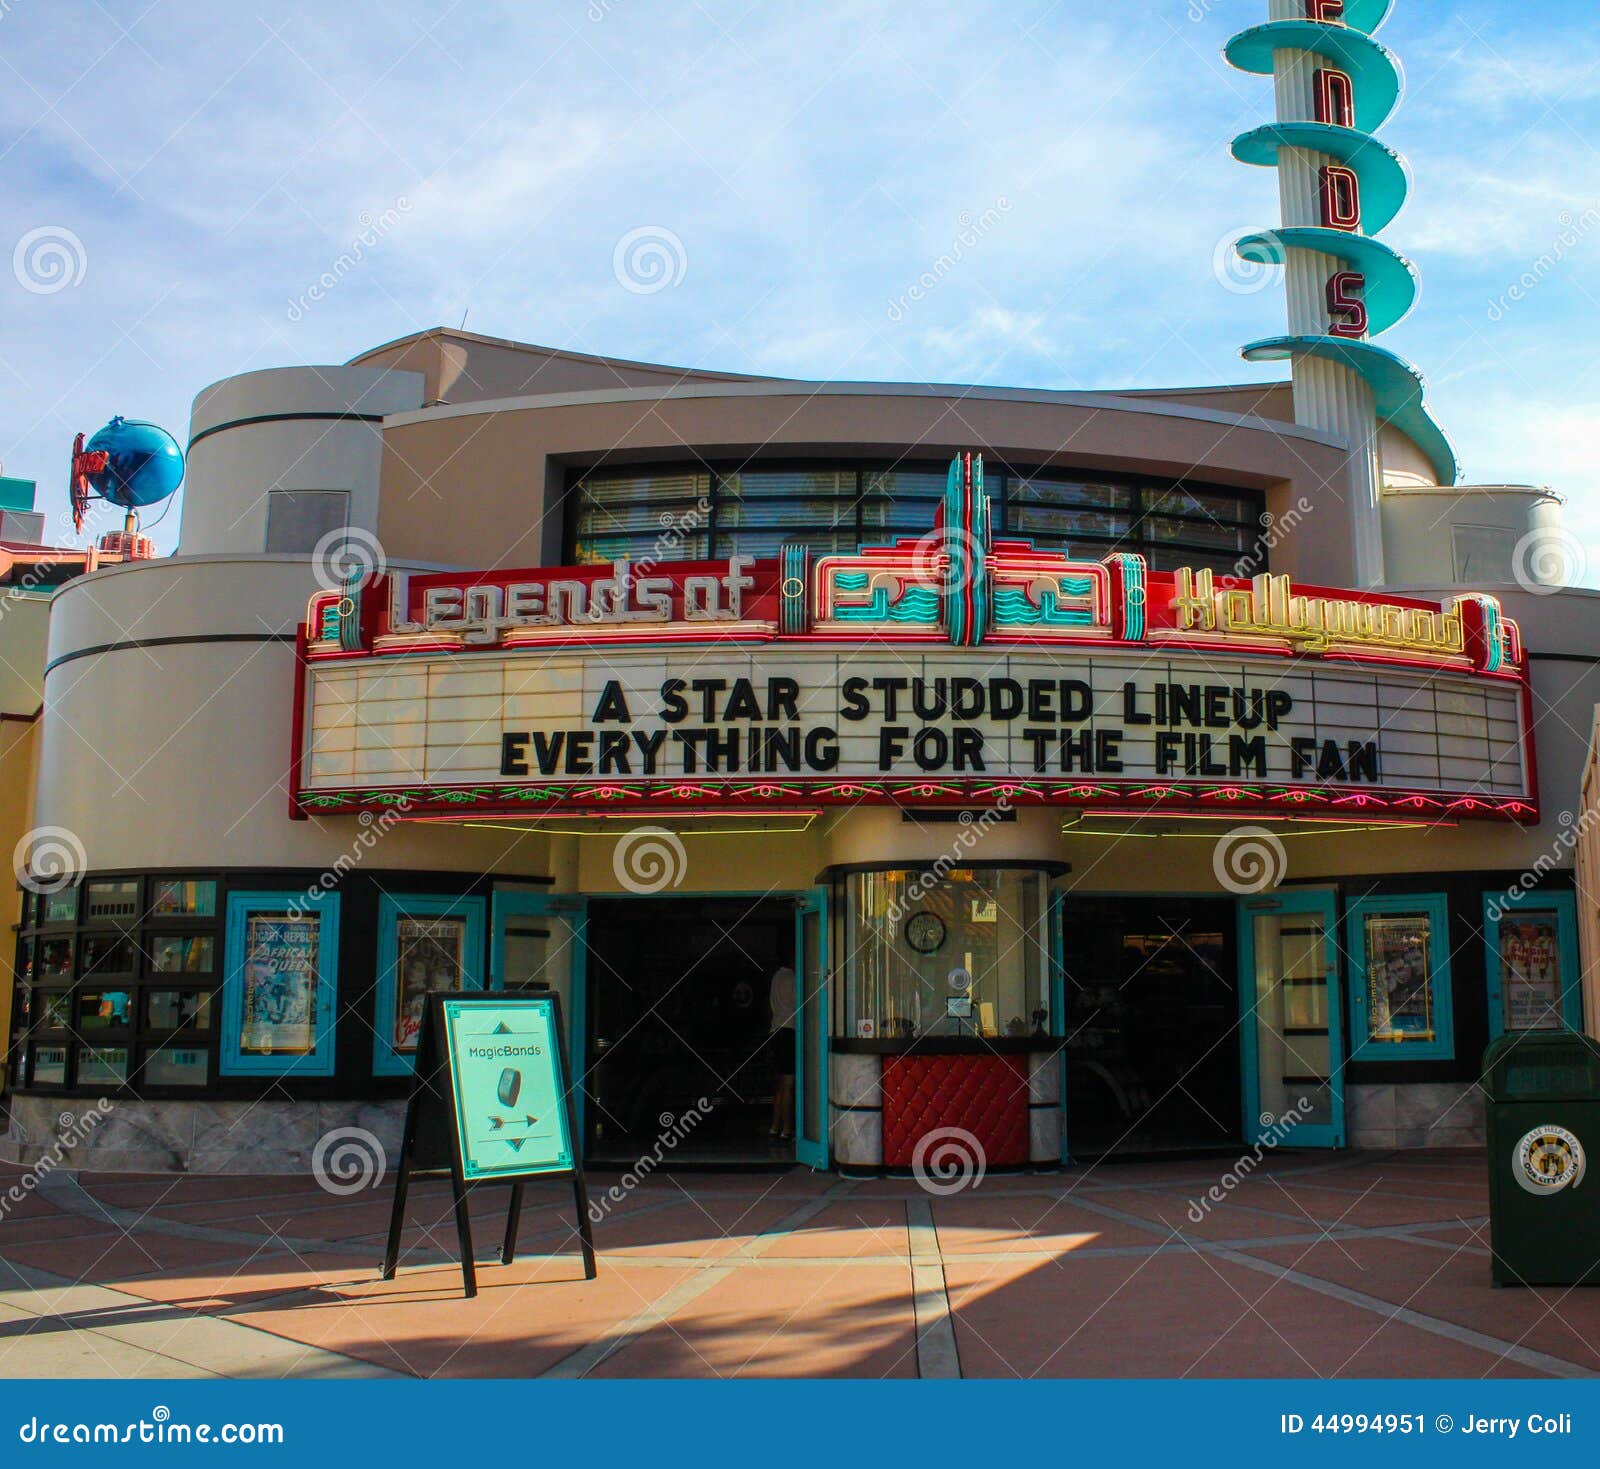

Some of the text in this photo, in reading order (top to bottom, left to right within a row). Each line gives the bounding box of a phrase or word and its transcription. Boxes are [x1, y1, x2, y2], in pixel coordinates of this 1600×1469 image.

[1173, 566, 1464, 652] Hollywood
[592, 677, 1292, 731] A STAR STUDDED LINEUP
[501, 726, 1378, 782] EVERYTHING FOR THE FILM FAN
[469, 1045, 541, 1059] MagicBands
